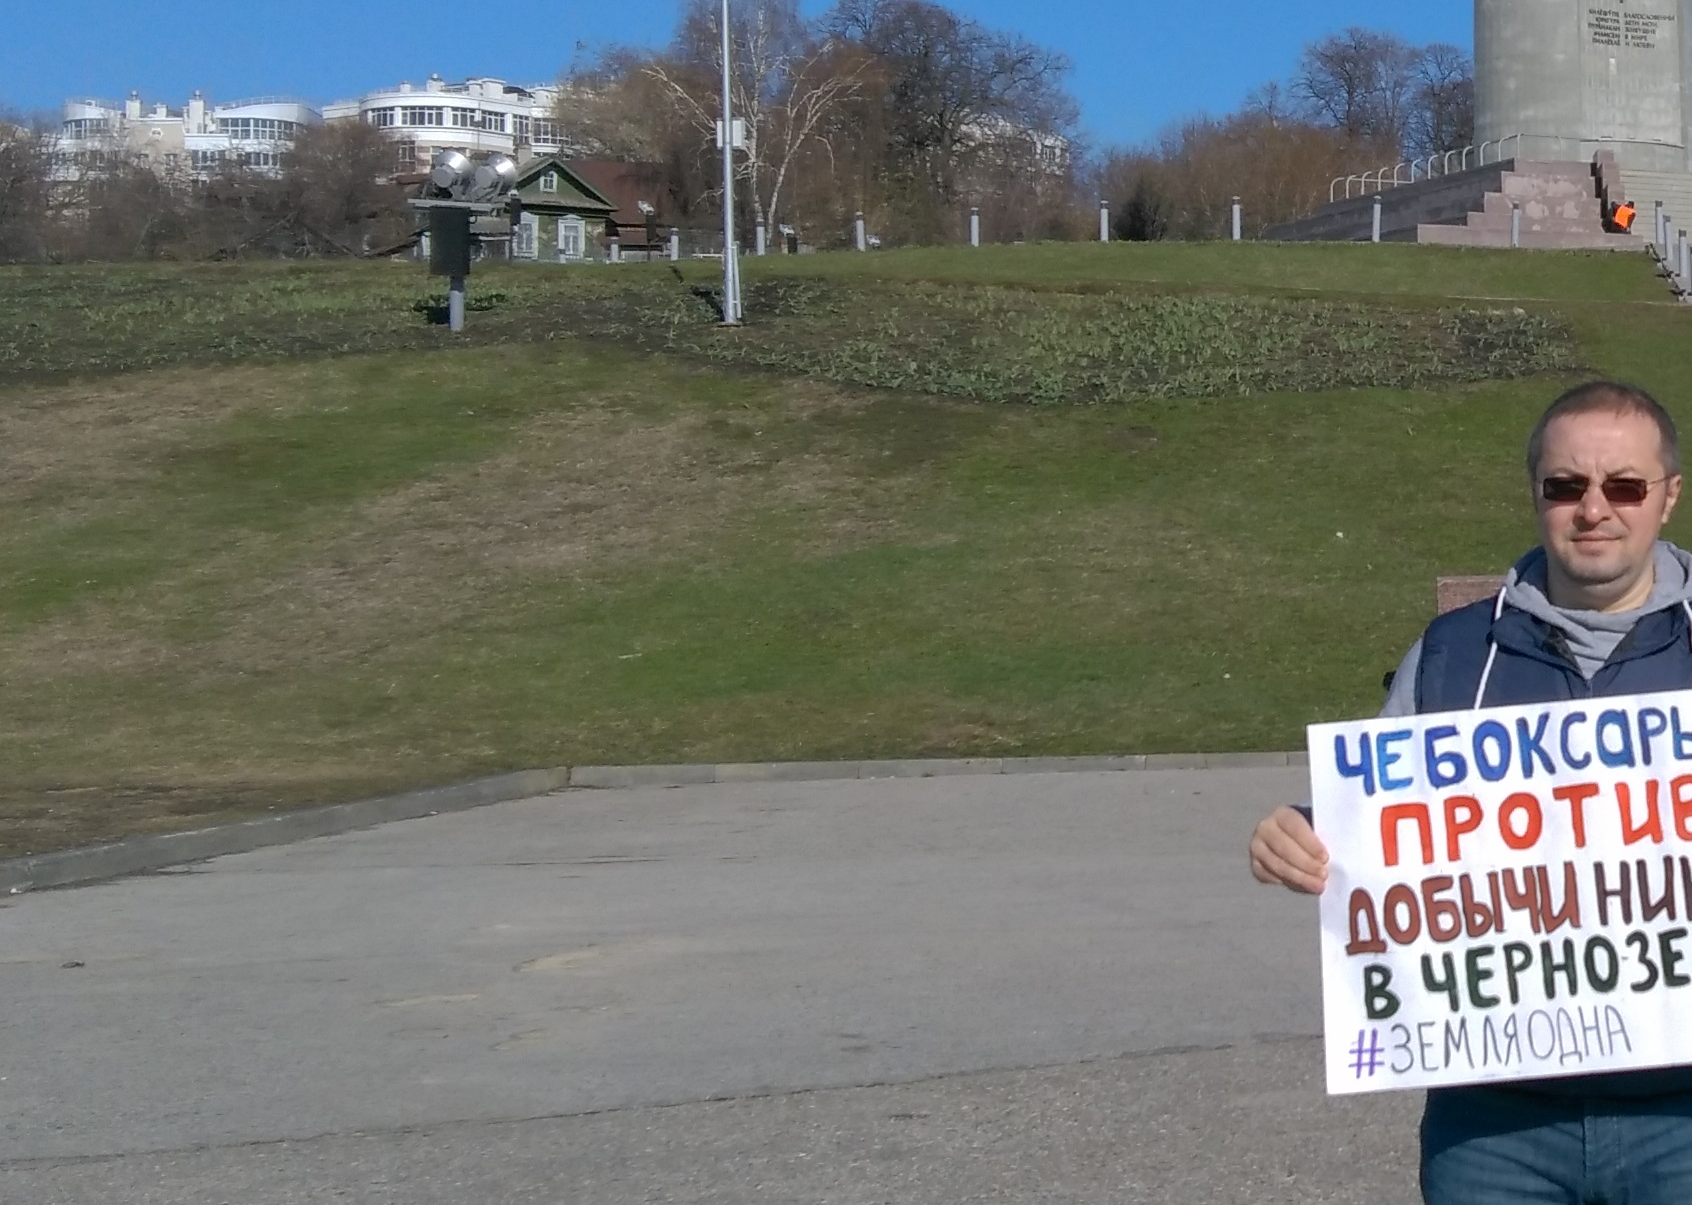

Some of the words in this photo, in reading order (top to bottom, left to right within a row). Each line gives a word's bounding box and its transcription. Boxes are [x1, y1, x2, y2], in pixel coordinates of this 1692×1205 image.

[1345, 860, 1581, 956] ДОБЫЧИ
[1362, 964, 1401, 1020] В
[1348, 1004, 1632, 1079] #ЗЕМЛЯОДНА
